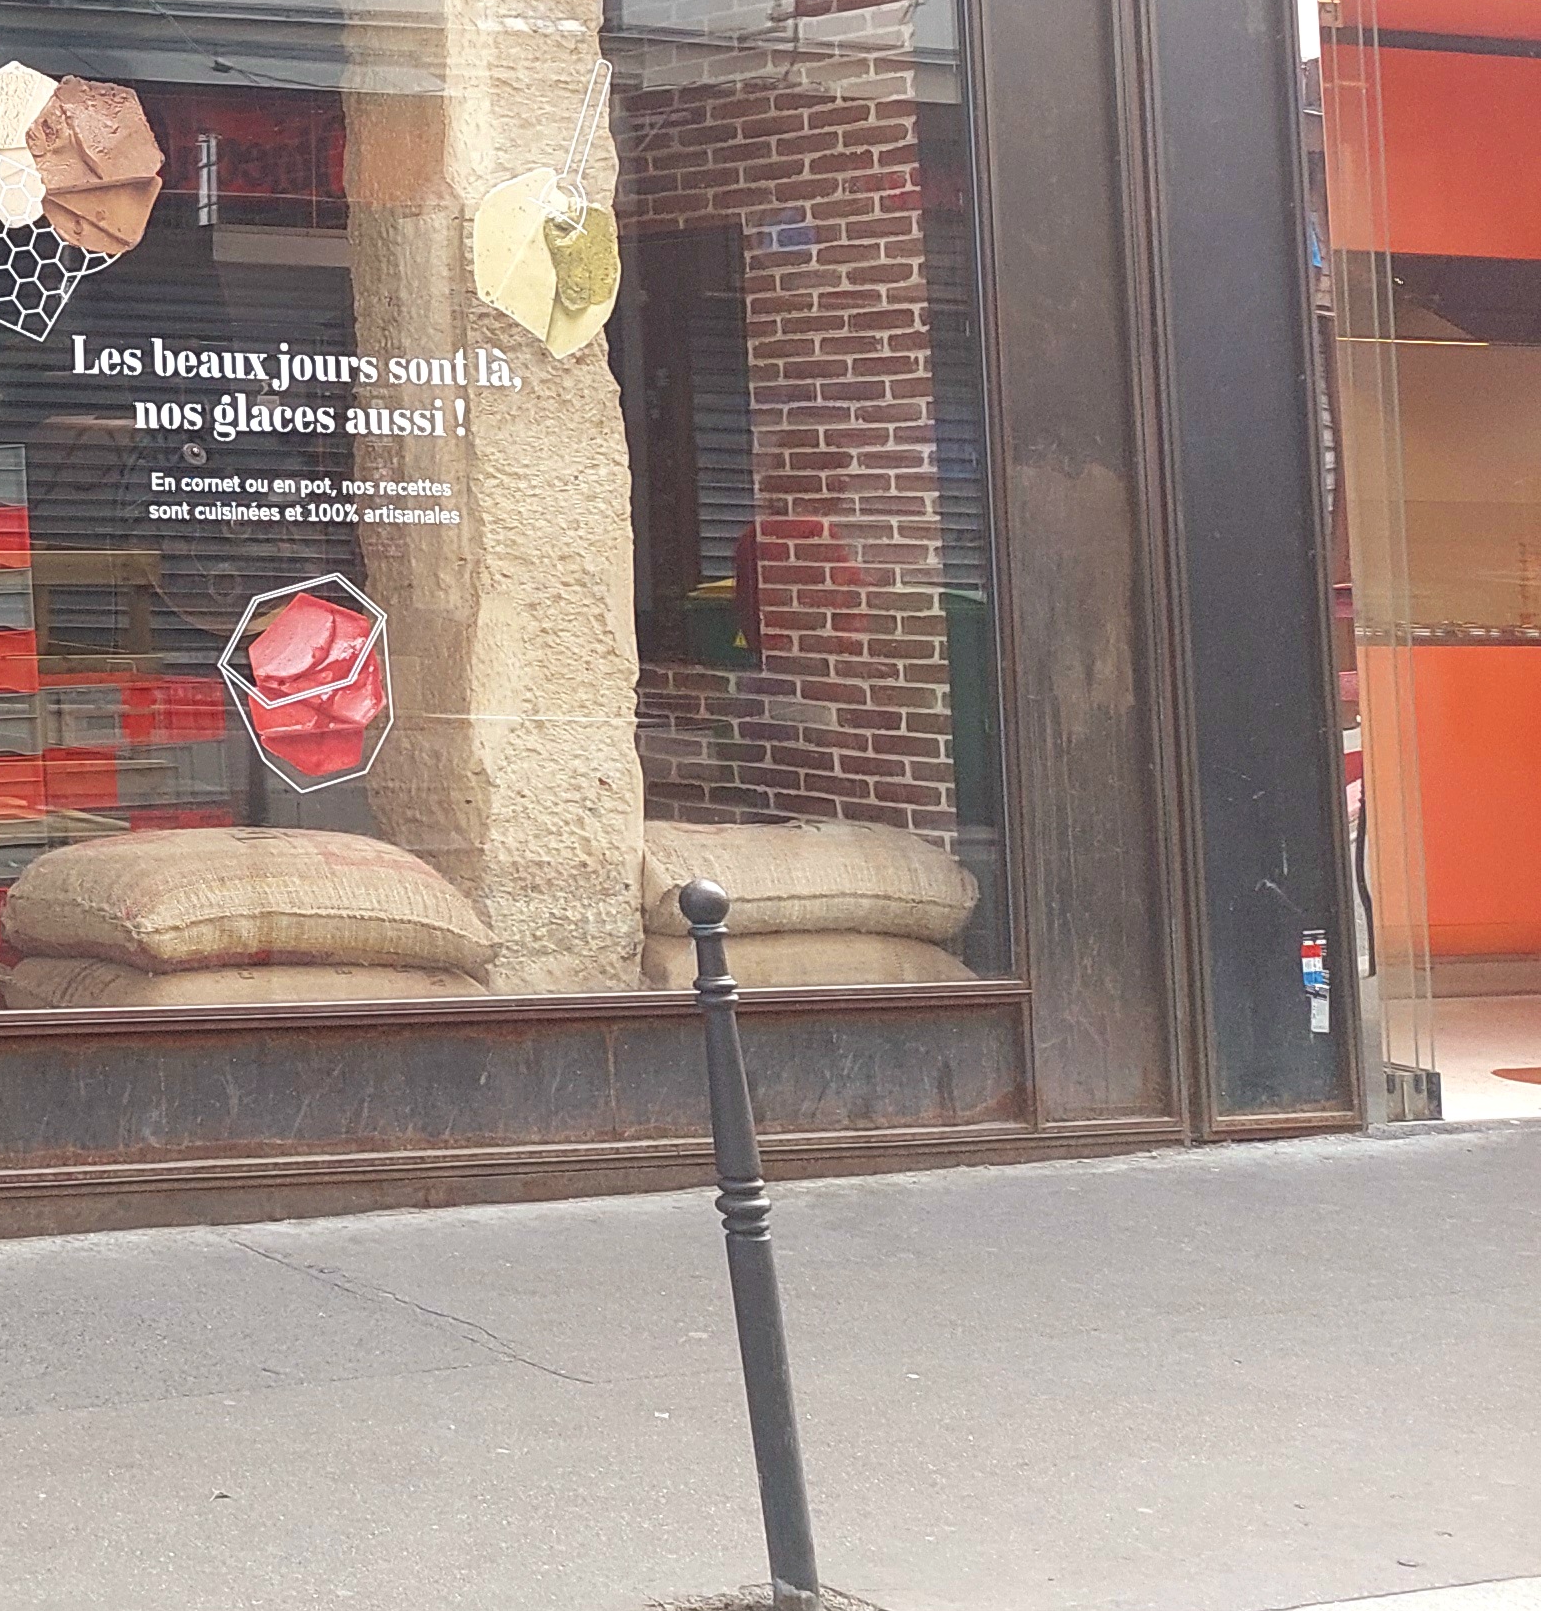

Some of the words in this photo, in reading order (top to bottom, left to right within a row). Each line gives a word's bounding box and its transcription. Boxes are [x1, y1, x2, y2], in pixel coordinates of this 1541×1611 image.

[71, 334, 143, 377] Les
[152, 338, 271, 382] beaux
[271, 342, 378, 391] jours
[388, 346, 468, 387] sont
[474, 347, 523, 394] là,
[133, 399, 203, 431] nos
[213, 392, 335, 442] glaces
[151, 472, 176, 493] En
[180, 475, 241, 494] cornet
[246, 478, 268, 494] ou
[273, 478, 296, 495] en
[299, 476, 337, 498] pot,
[342, 480, 375, 496] nos
[379, 478, 452, 497] recettes
[149, 502, 190, 521] sont
[194, 501, 281, 522] cuisinées
[284, 504, 303, 522] et
[306, 502, 359, 524] 100%
[364, 504, 461, 525] artisanales
